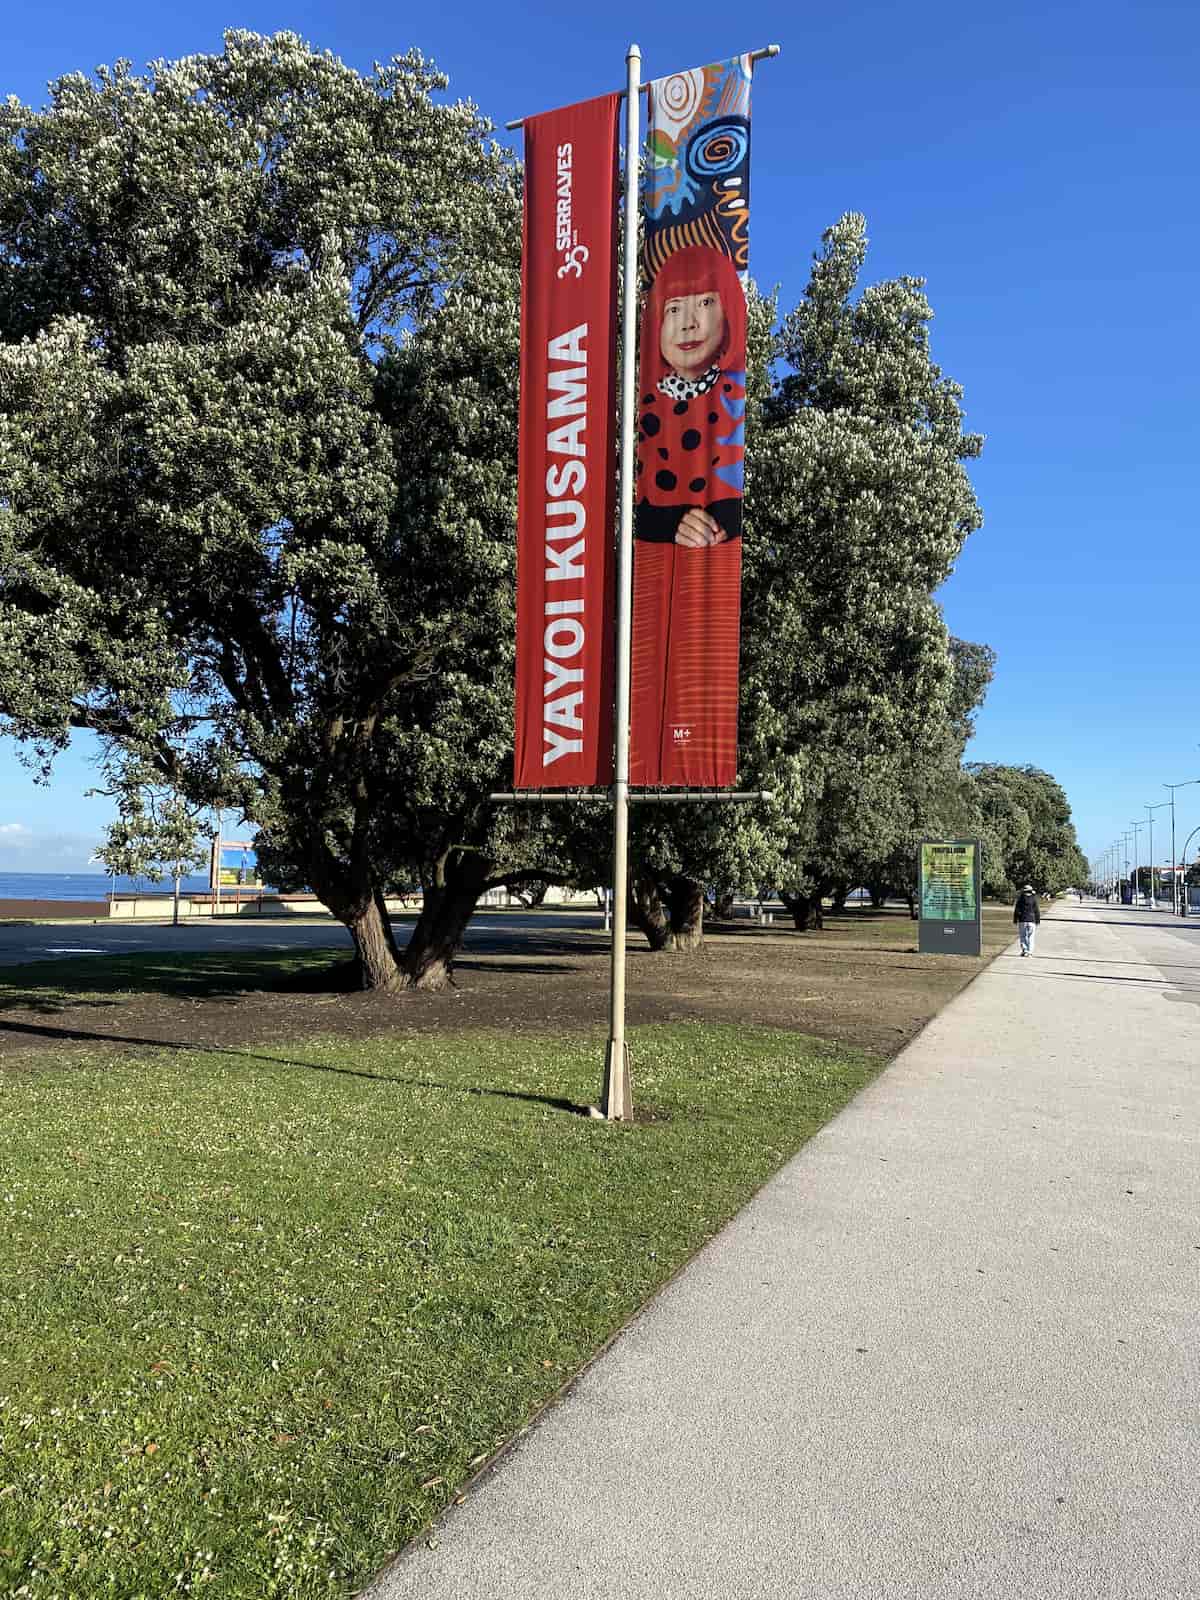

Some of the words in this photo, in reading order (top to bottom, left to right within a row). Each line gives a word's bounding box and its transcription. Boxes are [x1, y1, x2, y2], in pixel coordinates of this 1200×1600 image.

[556, 143, 573, 251] SERRAVES
[544, 322, 588, 582] KUSAMA
[543, 599, 585, 767] YAYOI
[673, 728, 692, 739] M+
